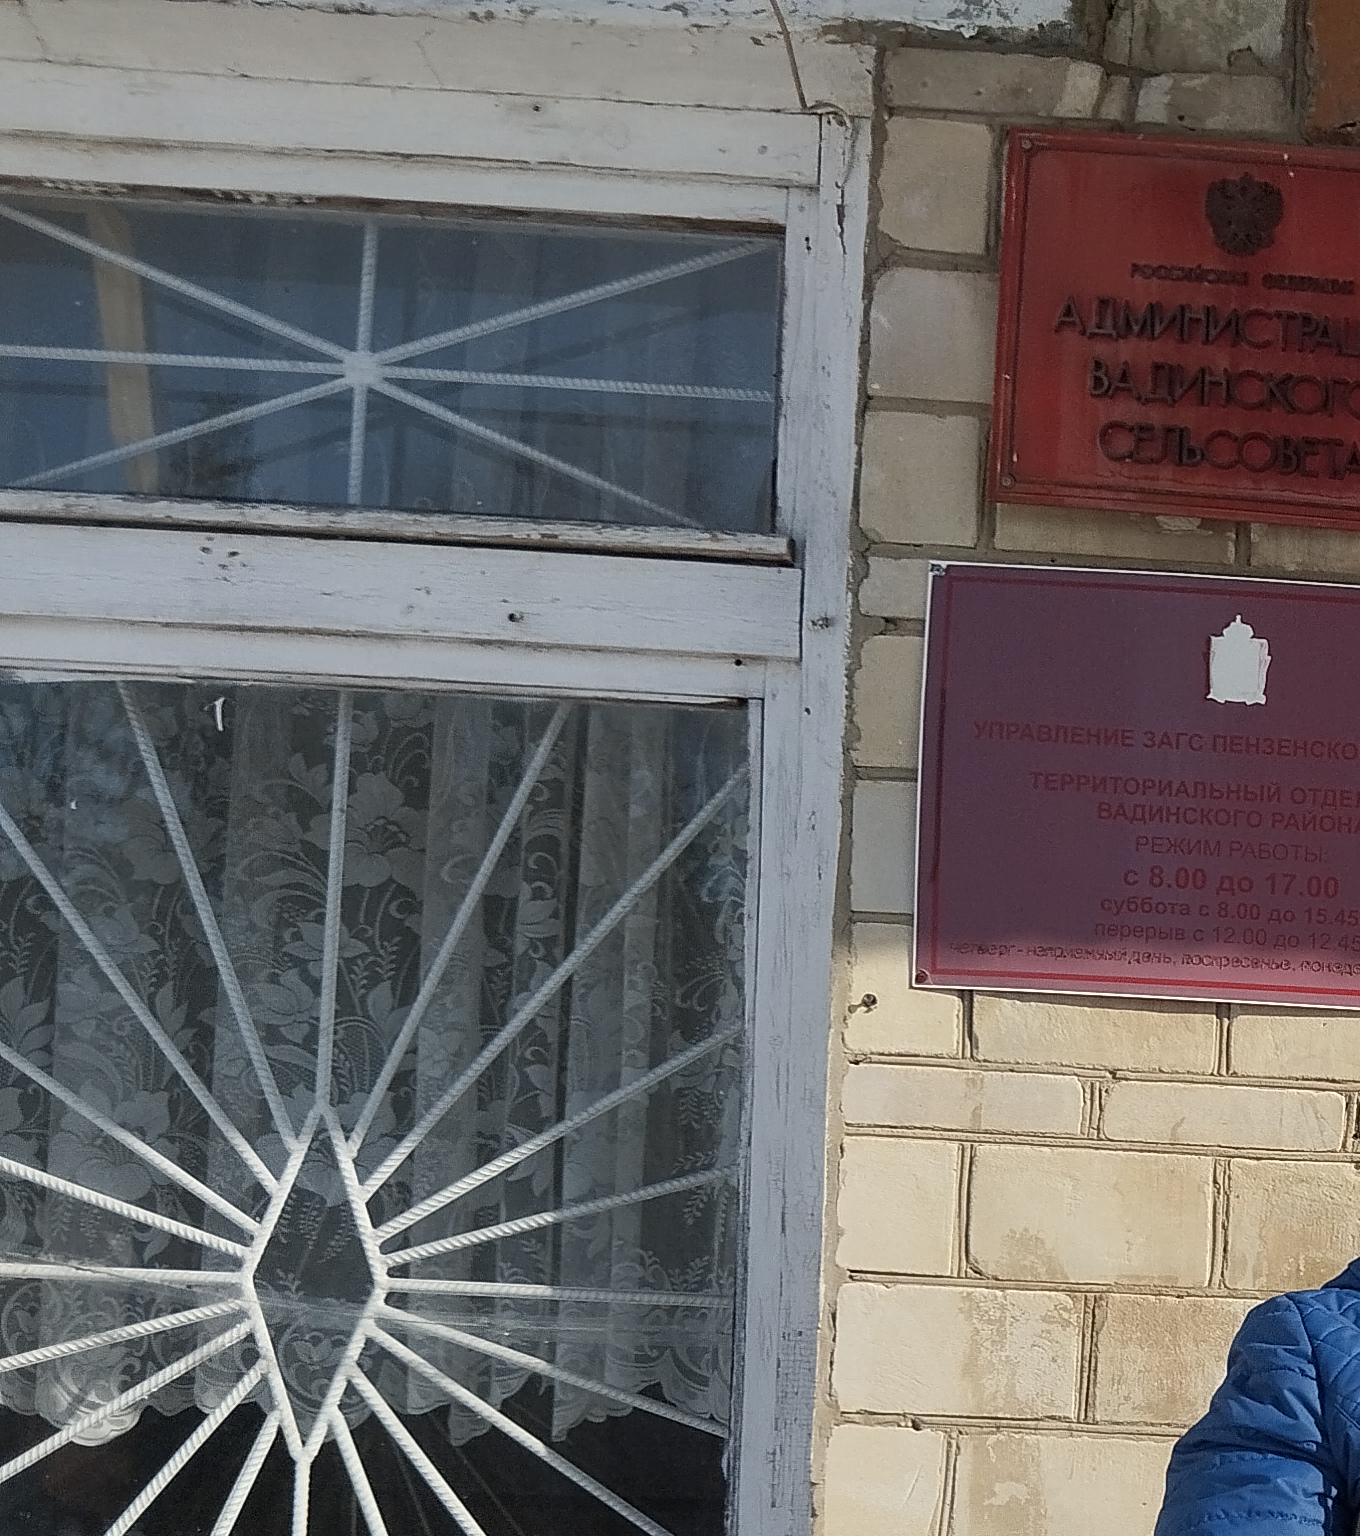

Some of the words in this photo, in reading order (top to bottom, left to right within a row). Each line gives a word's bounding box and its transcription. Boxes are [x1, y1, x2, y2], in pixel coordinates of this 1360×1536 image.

[973, 720, 1135, 749] УПРАВЛЕНИЕ
[1143, 729, 1205, 752] ЗАГС
[1029, 771, 1282, 804] ТЕРРИТОРИАЛЬНЫЙ
[1097, 802, 1263, 831] ВАДИНСКОГО
[1135, 836, 1222, 860] РЕЖИМ
[1147, 866, 1207, 891] 8.00
[1215, 875, 1254, 896] до
[1266, 872, 1340, 899] 17.00
[1100, 896, 1192, 920] суббота
[1217, 902, 1261, 921] 8.00
[1267, 909, 1297, 927] до
[1304, 907, 1360, 927] 15.45
[1094, 922, 1186, 945] перерыв
[1212, 926, 1267, 947] 12.00
[1273, 933, 1302, 951] до
